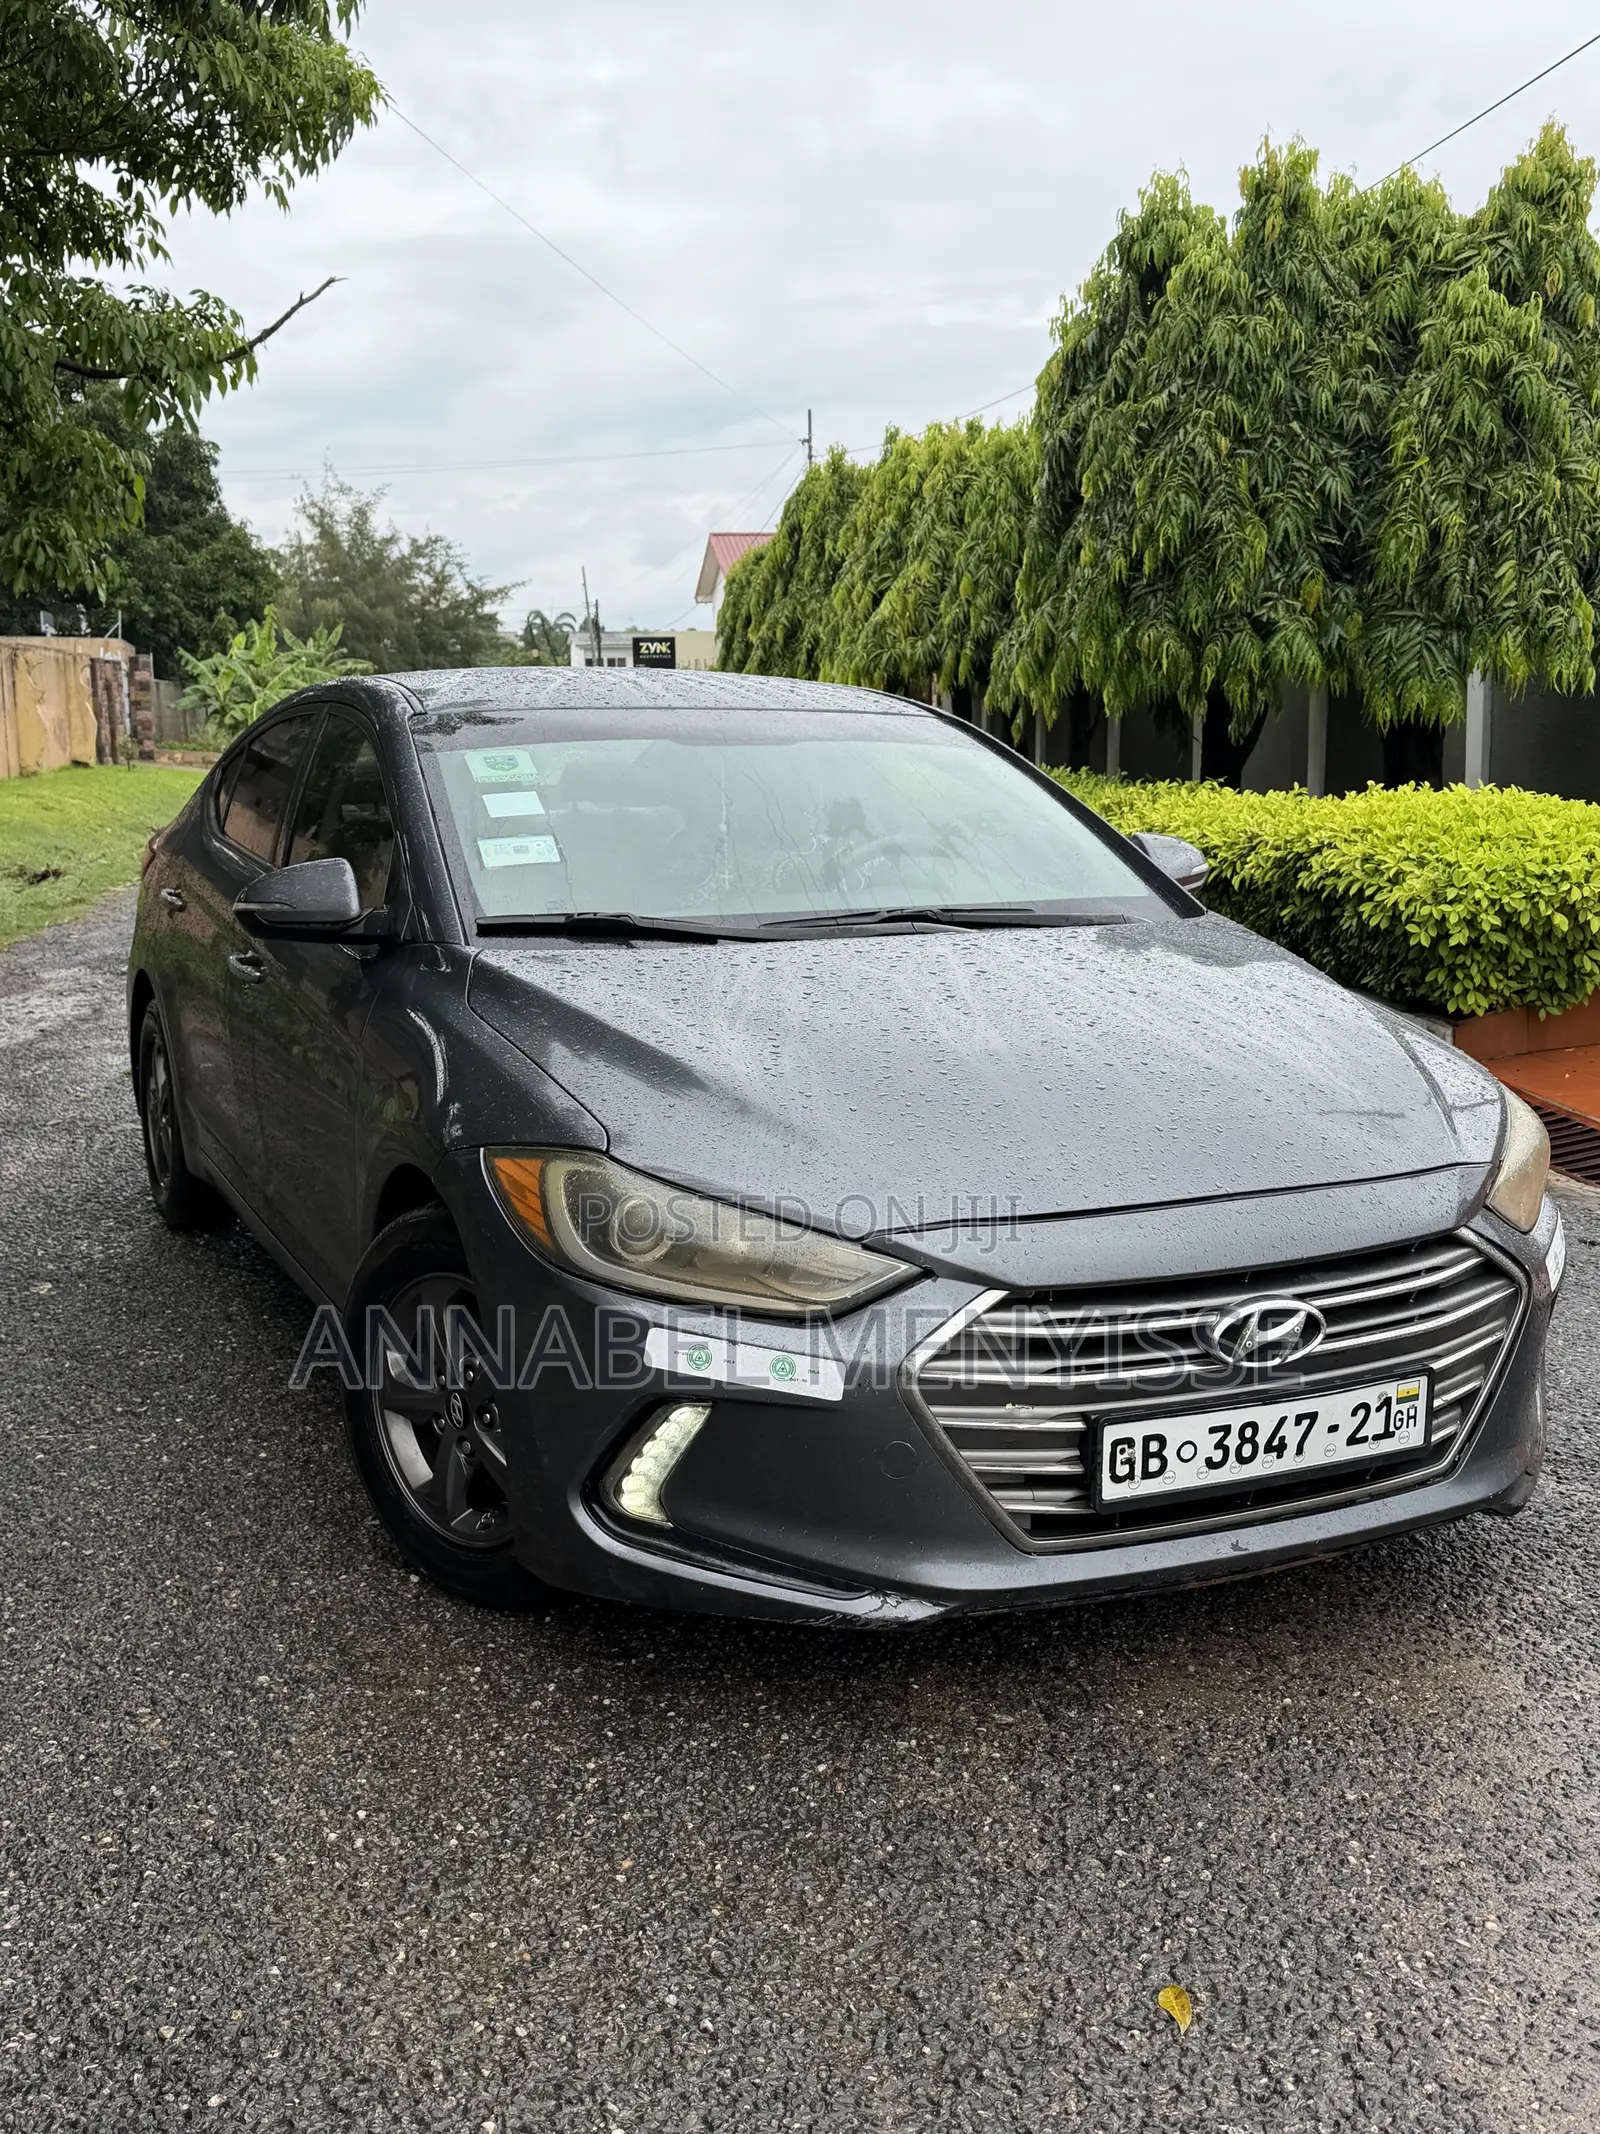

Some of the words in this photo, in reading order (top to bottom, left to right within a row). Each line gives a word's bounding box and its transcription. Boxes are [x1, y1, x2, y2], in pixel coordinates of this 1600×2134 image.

[639, 641, 671, 654] ZYNK
[1393, 1404, 1417, 1431] GH
[1109, 1433, 1168, 1484] GB
